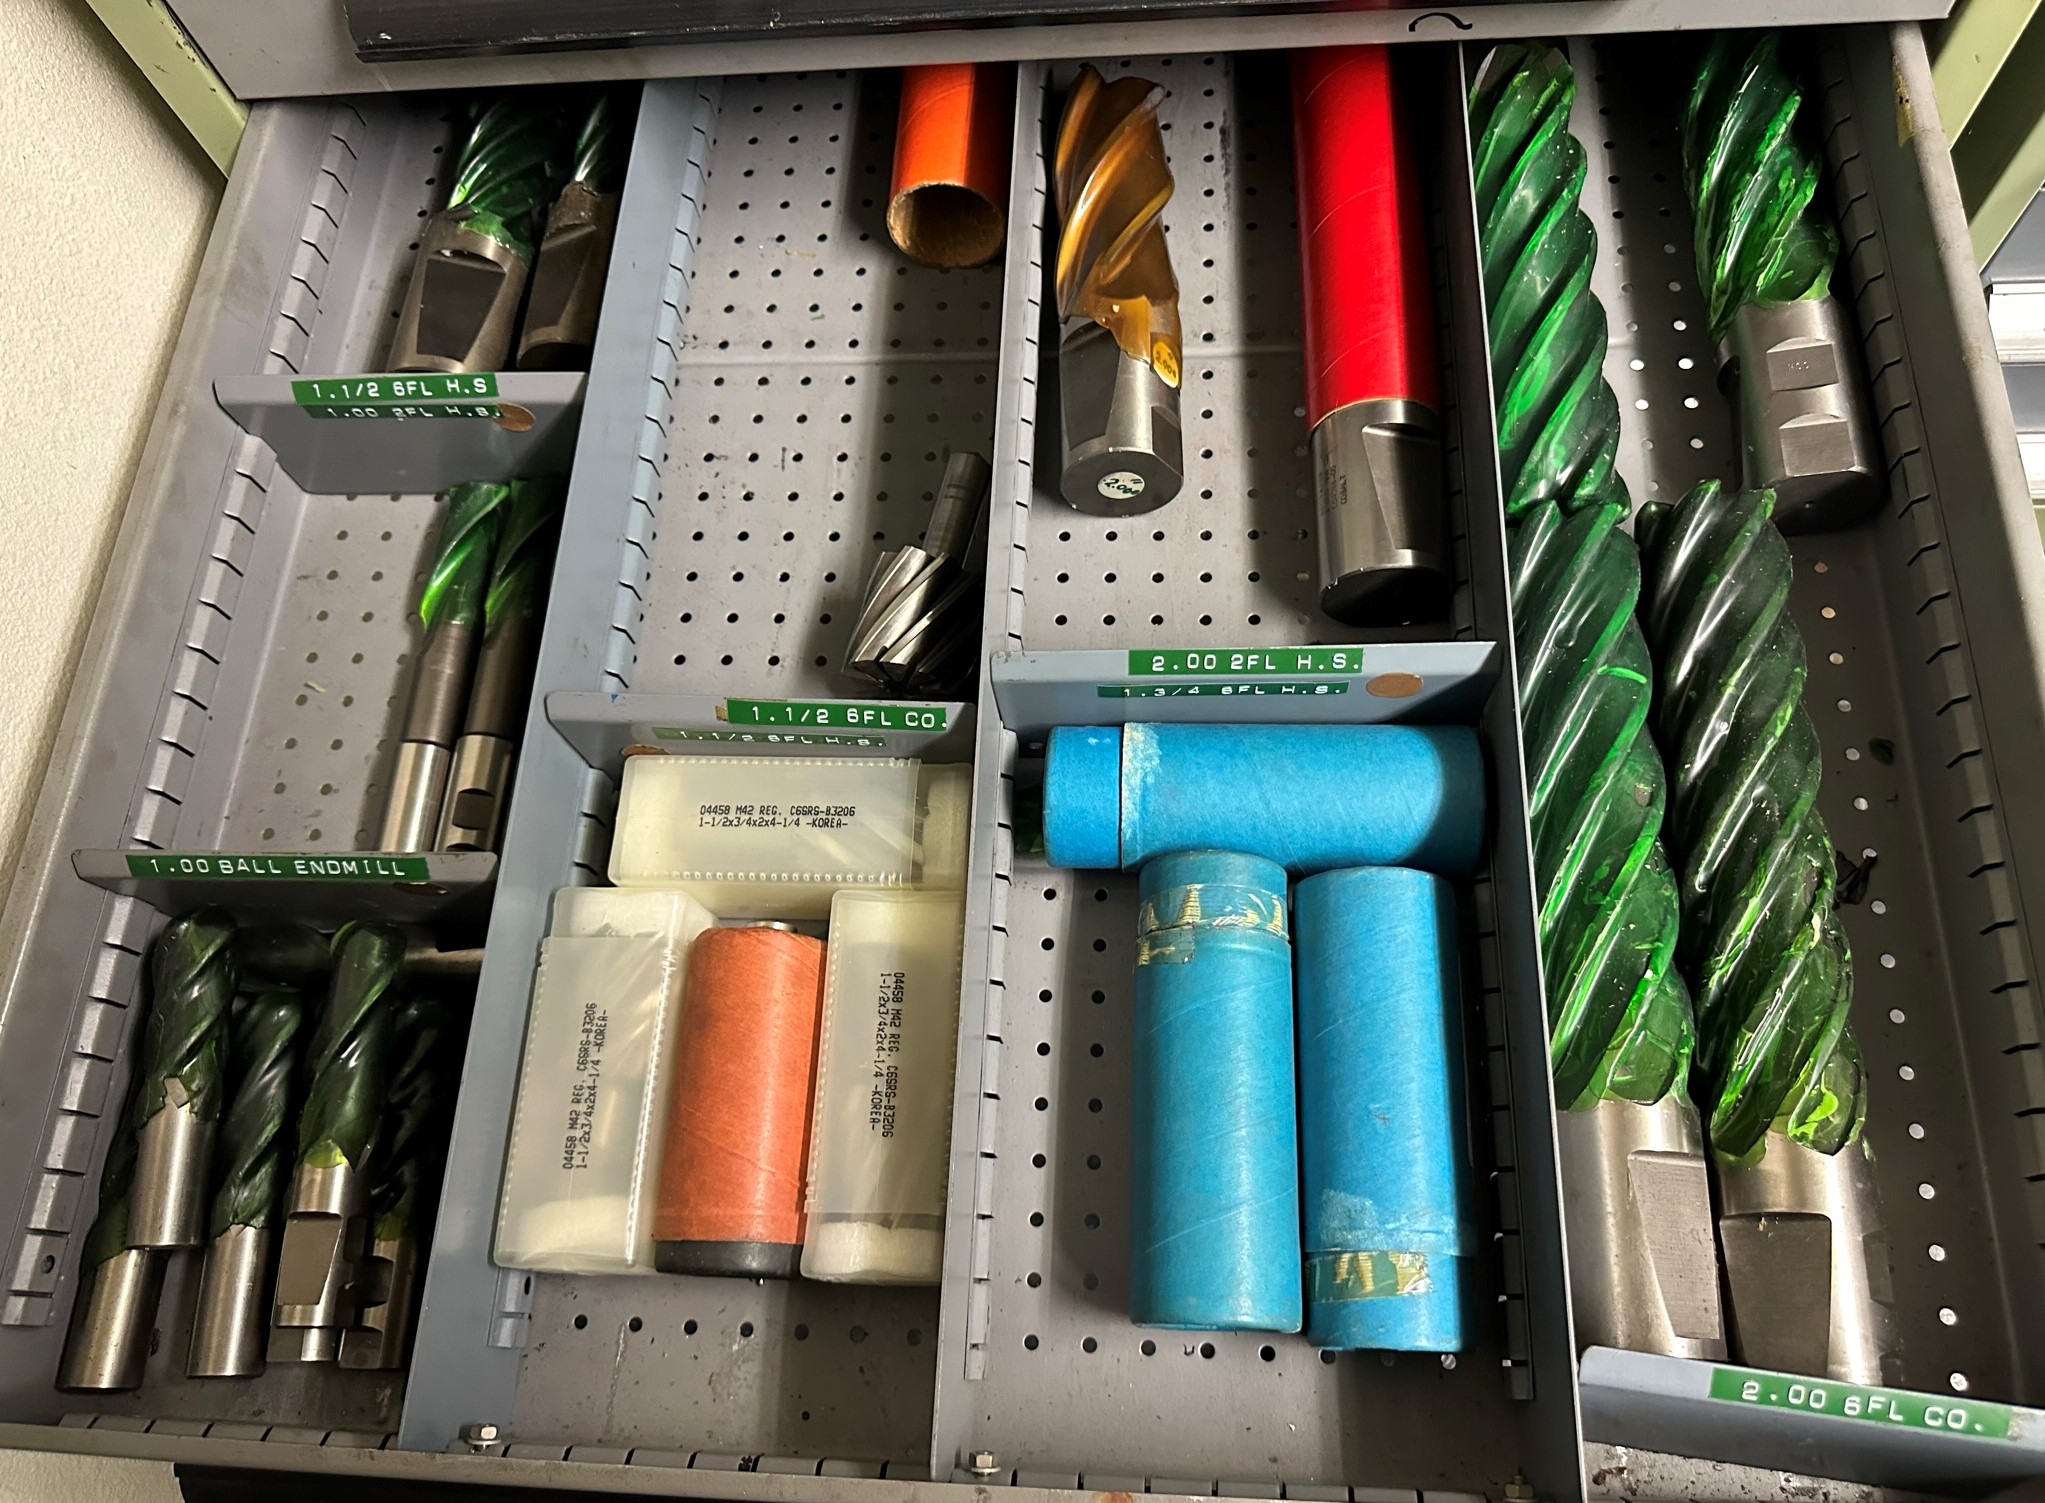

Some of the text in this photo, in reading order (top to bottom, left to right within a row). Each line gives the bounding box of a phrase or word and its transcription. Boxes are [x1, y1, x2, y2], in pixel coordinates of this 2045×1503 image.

[312, 378, 488, 399] 1.1/2 6FL H.S
[326, 407, 379, 418] 1.00
[1151, 652, 1360, 672] 2.00 2FL H.S.
[1123, 684, 1341, 698] 1.3/4 6FL H.S.
[751, 706, 948, 729] 1.1/2 6FL CO.
[679, 730, 756, 743] 1.1/2
[700, 804, 856, 817] 04458 M42 REG. C6SRS-B3206
[698, 816, 849, 829] 1-1/2x3/4x2x4-1/4 -KOREA-
[150, 858, 406, 877] 1.00 BALL ENDMILL
[891, 971, 906, 1004] 04458
[889, 1008, 902, 1028] M42
[592, 1008, 609, 1053] -KOREA-
[887, 1033, 901, 1058] REG.
[571, 1078, 587, 1105] REG.
[868, 1083, 884, 1132] -KOREA-
[567, 1109, 582, 1130] M42
[562, 1135, 578, 1170] 04458
[1741, 1379, 1984, 1432] 2.00 6FL CO.
